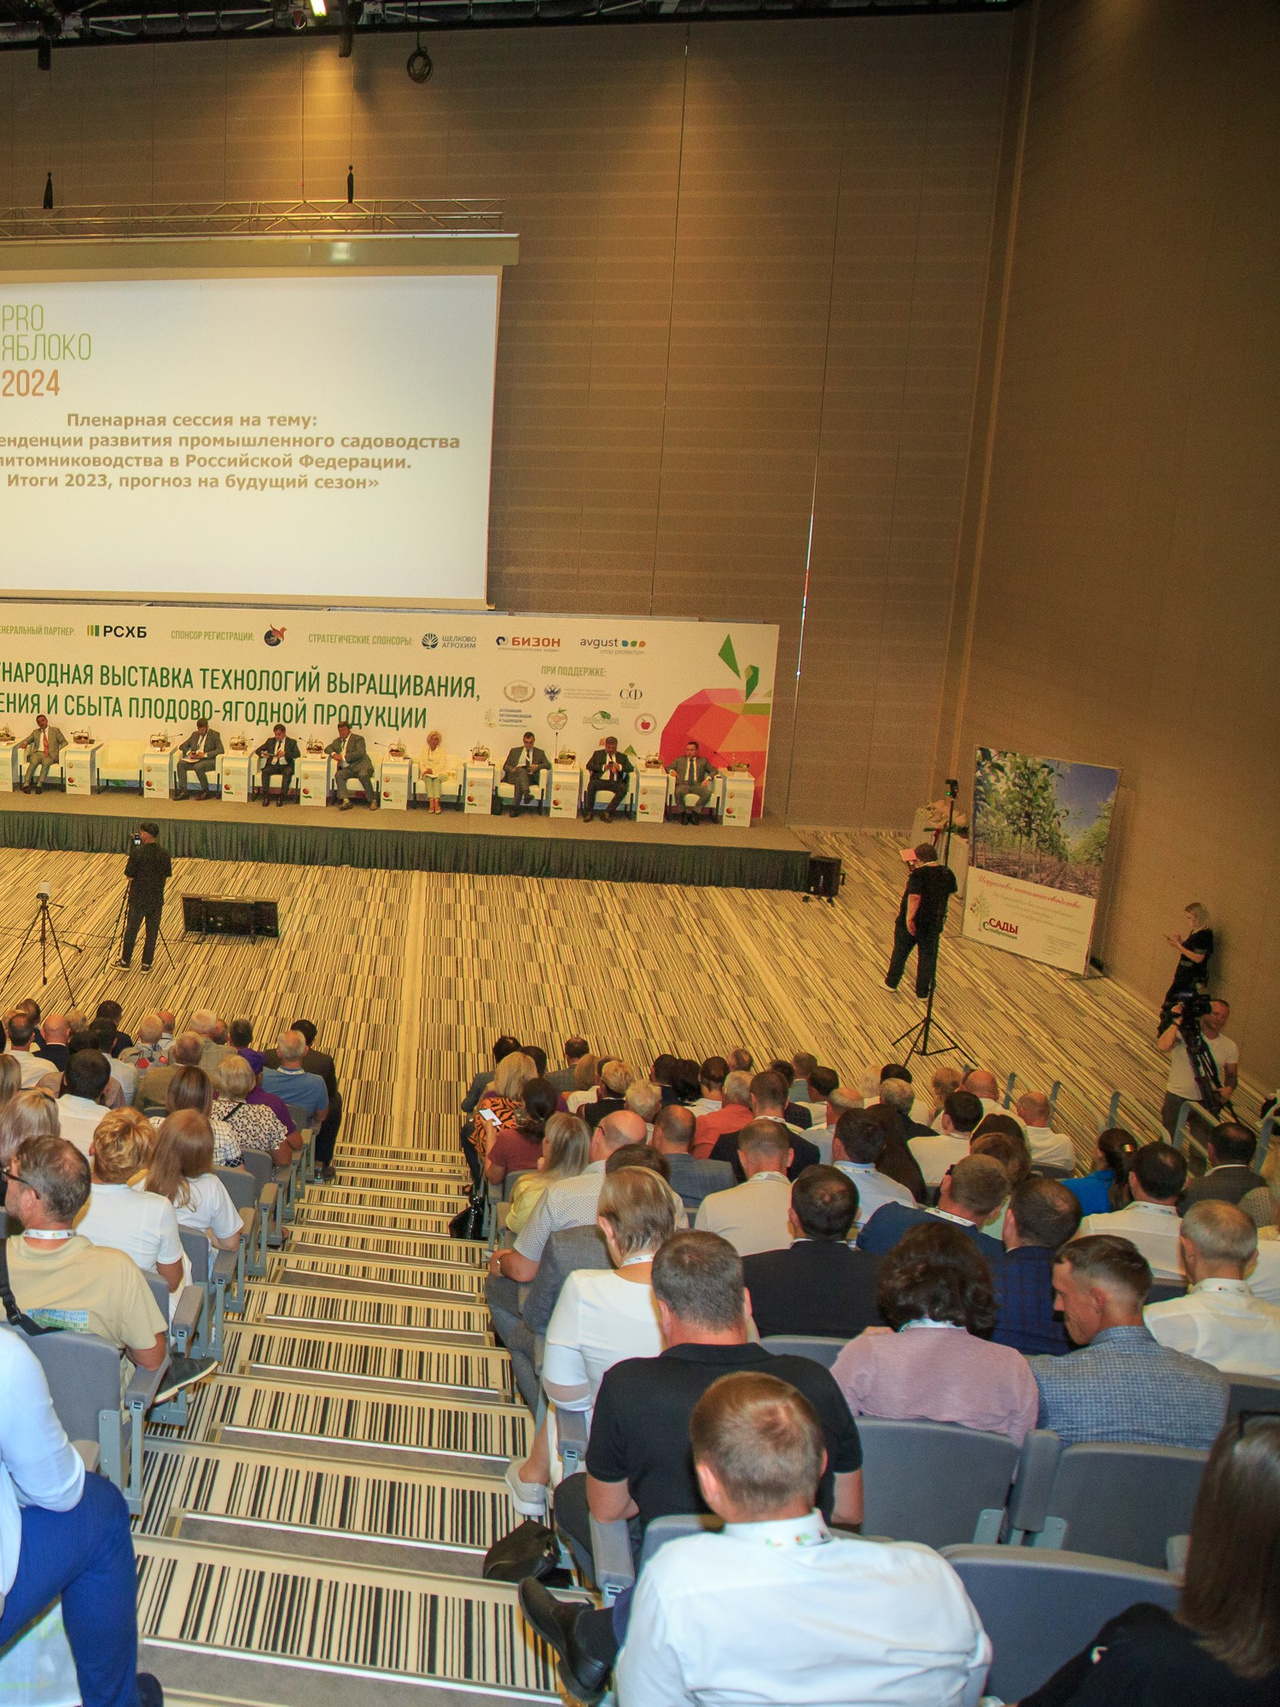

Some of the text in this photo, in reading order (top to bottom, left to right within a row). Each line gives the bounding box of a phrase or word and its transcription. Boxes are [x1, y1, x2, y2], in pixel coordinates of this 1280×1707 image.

[1, 304, 44, 332] PRO
[1, 333, 92, 361] ЯБЛОКО
[1, 369, 60, 397] 2024
[67, 413, 318, 430] Пленарная сессия на тему:
[89, 435, 172, 450] развития
[179, 435, 335, 450] промышленного
[340, 436, 460, 450] садоводства
[170, 456, 180, 467] в
[186, 453, 293, 468] Российской
[298, 454, 412, 472] Федерации.
[7, 474, 380, 491] Итоги 2023, прогноз на будущий сезон»
[44, 626, 76, 637] ПАРТНЕР:
[103, 625, 147, 639] РСХБ
[171, 630, 255, 642] СПОНСОР РЕГИСТРАЦИИ:
[442, 635, 477, 643] ЩЕЛКОВО
[308, 633, 414, 646] СТРАТЕГИЧЕСКИЕ СПОНСОРЫ:
[511, 636, 561, 647] БИЗОН
[580, 637, 618, 649] avgust
[541, 666, 607, 677] ПРИ ПОДДЕРЖКЕ:
[100, 664, 194, 689] ВЫСТАВКА
[199, 665, 321, 693] ТЕХНОЛОГИЙ
[327, 672, 481, 702] ВЫРАЩИВАНИЯ,
[47, 694, 58, 715] И
[64, 694, 123, 718] СБЫТА
[129, 697, 307, 726] ПЛОДОВО-ЯГОДНОЙ
[313, 703, 427, 731] ПРОДУКЦИИ
[988, 918, 1018, 934] САДЫ
